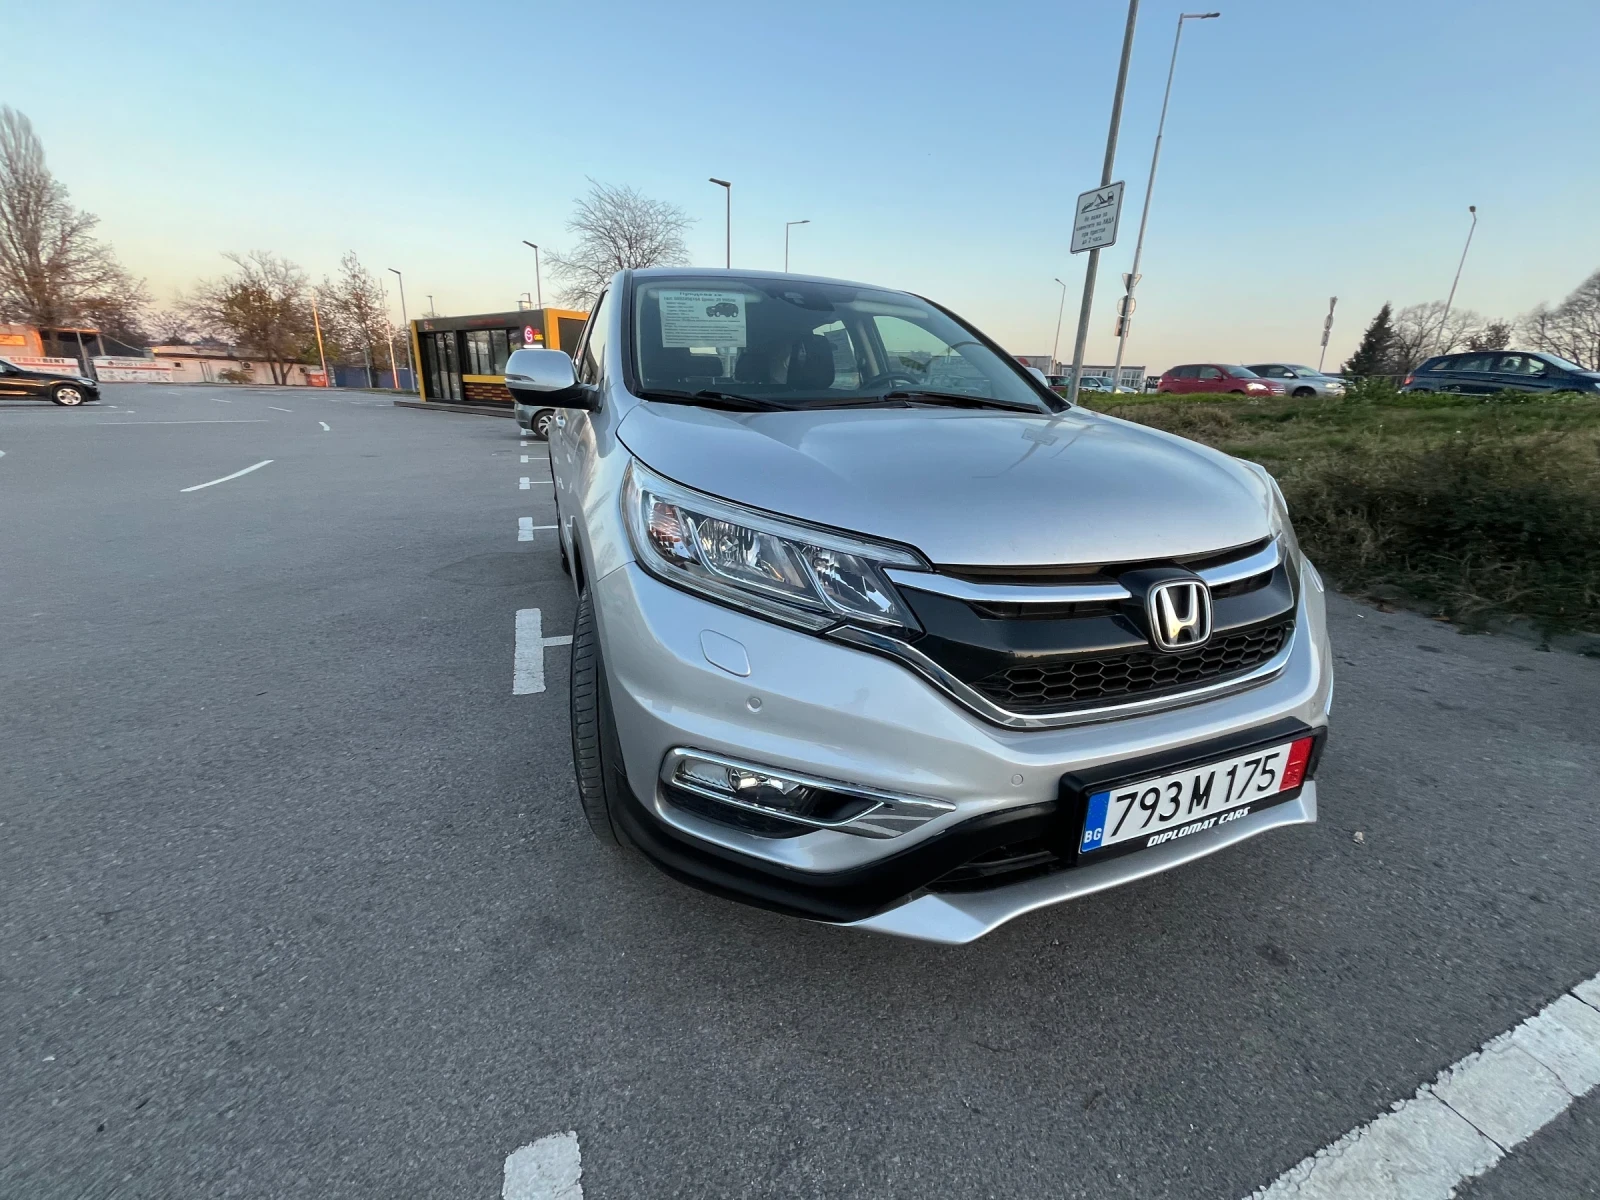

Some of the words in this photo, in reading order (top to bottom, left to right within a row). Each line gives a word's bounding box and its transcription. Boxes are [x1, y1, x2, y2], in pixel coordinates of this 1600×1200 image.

[1110, 780, 1183, 837] 793
[1187, 770, 1216, 815] M
[1224, 752, 1280, 803] 175
[1083, 827, 1102, 844] BG
[1146, 817, 1218, 848] DIPLOMAT
[1218, 806, 1252, 825] CARS
